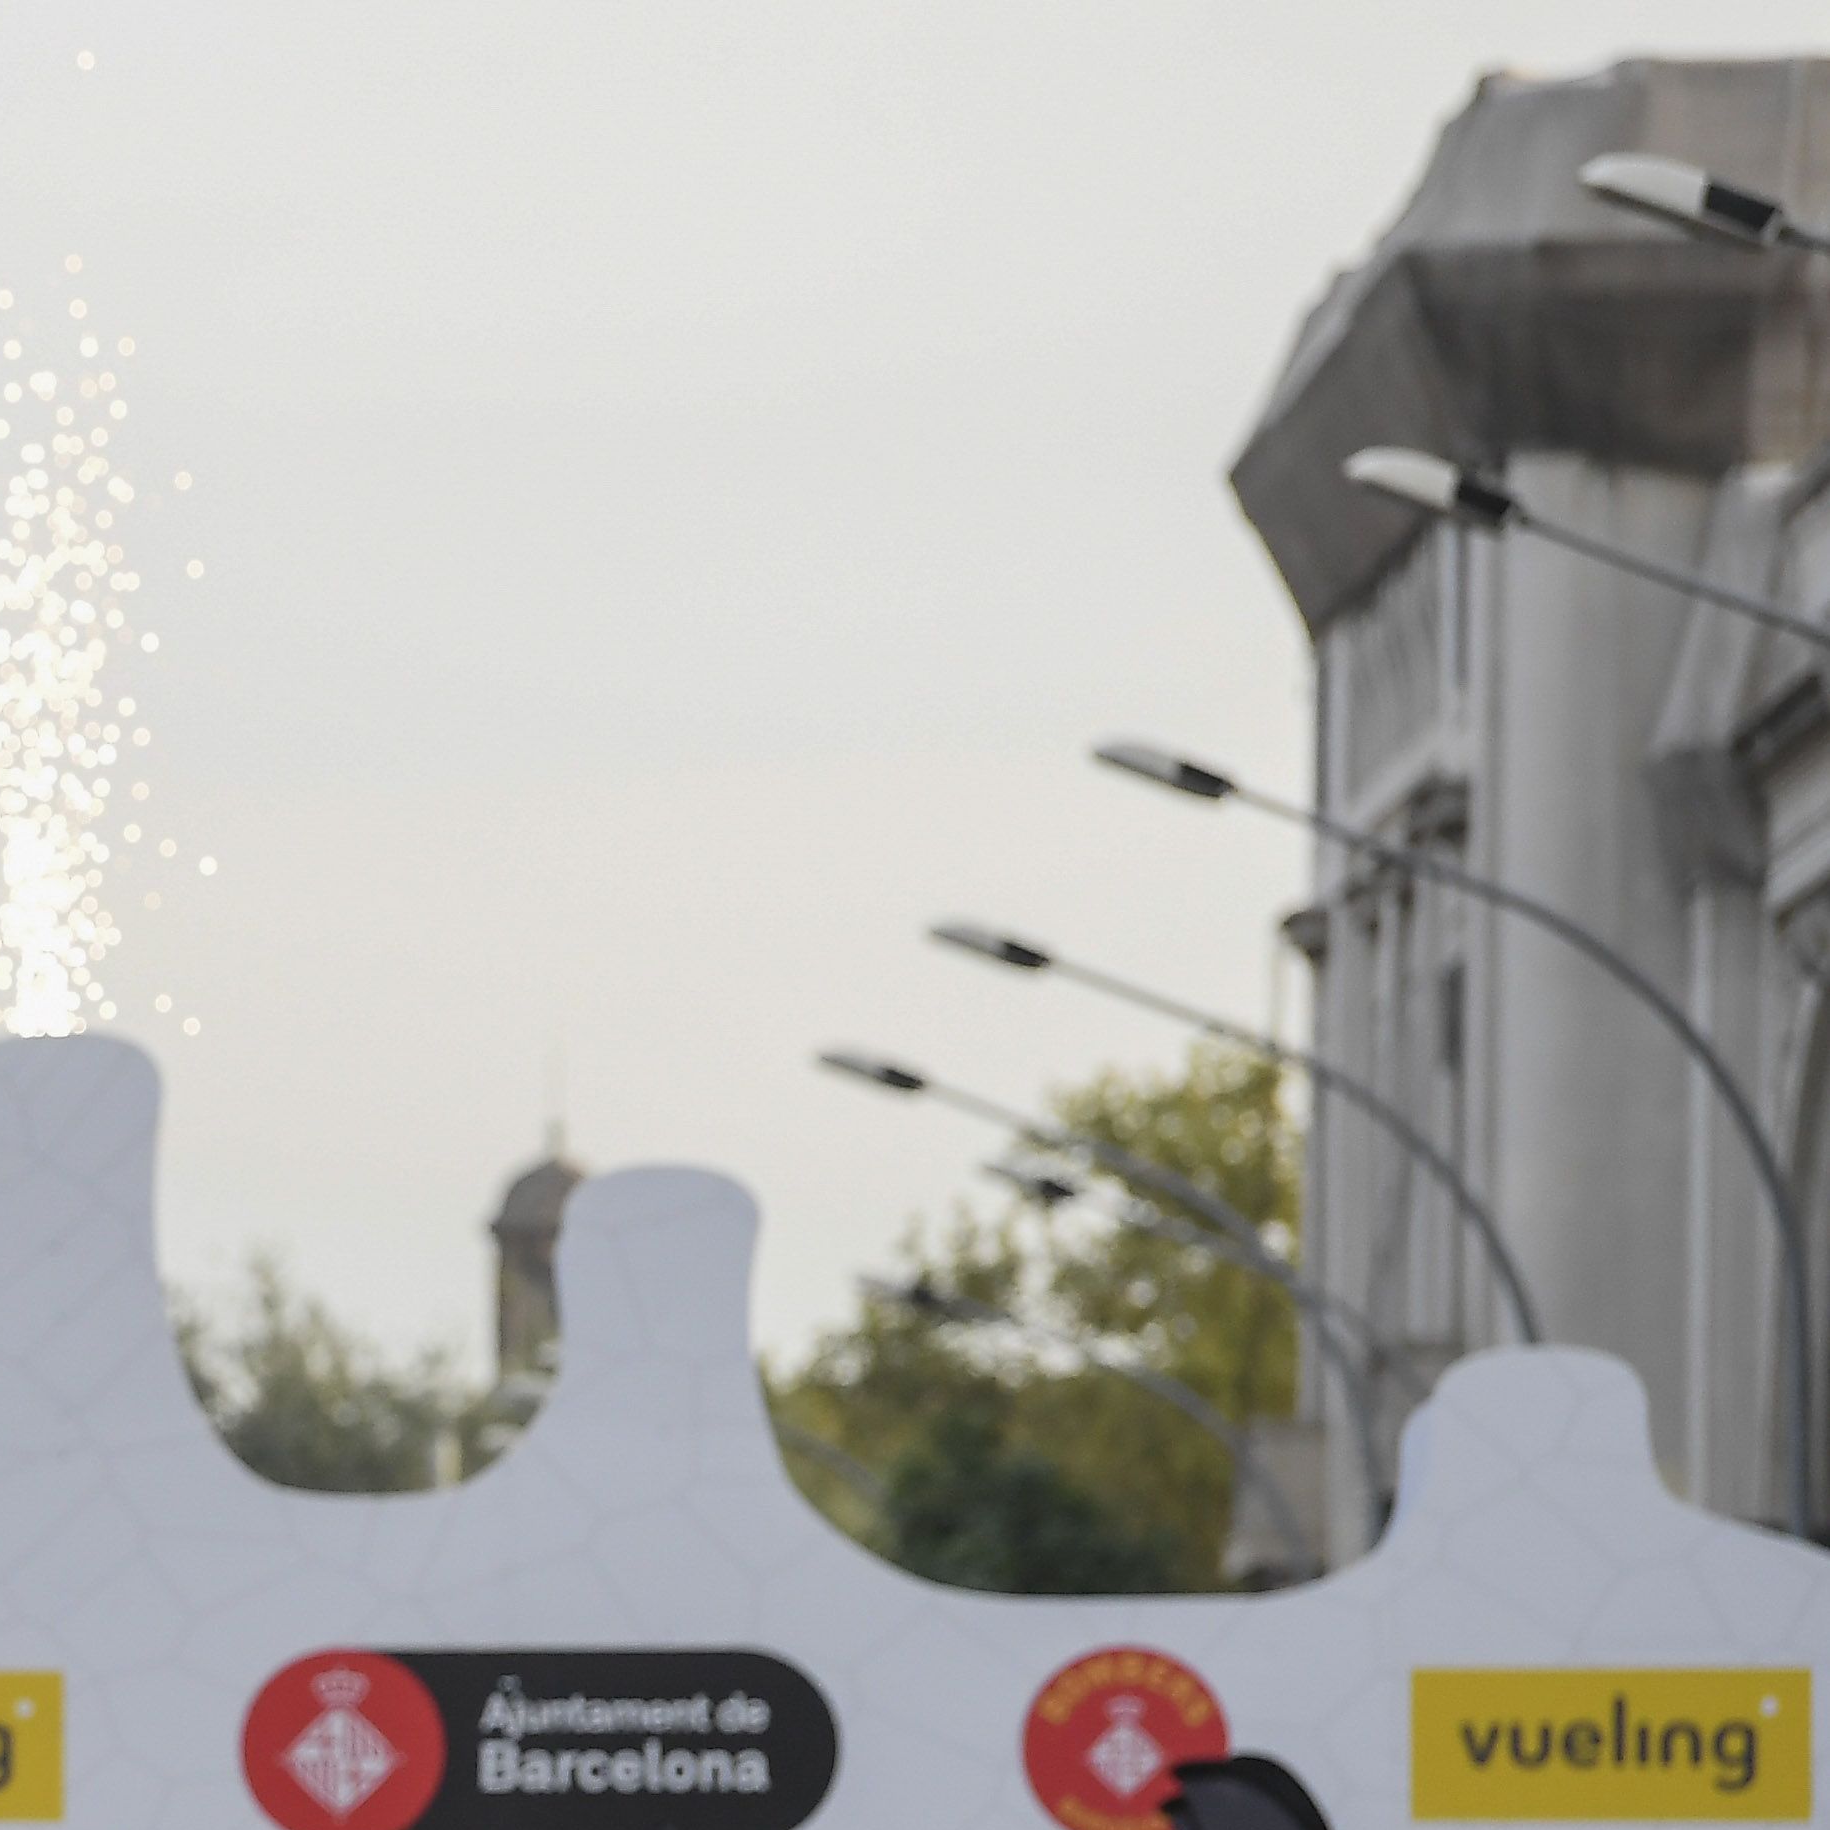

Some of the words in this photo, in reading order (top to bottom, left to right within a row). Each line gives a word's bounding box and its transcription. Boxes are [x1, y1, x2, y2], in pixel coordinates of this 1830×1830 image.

[480, 1693, 706, 1740] Ajuntament
[716, 1693, 770, 1734] de
[1461, 1695, 1758, 1791] vueling
[479, 1742, 770, 1795] Barcelona
